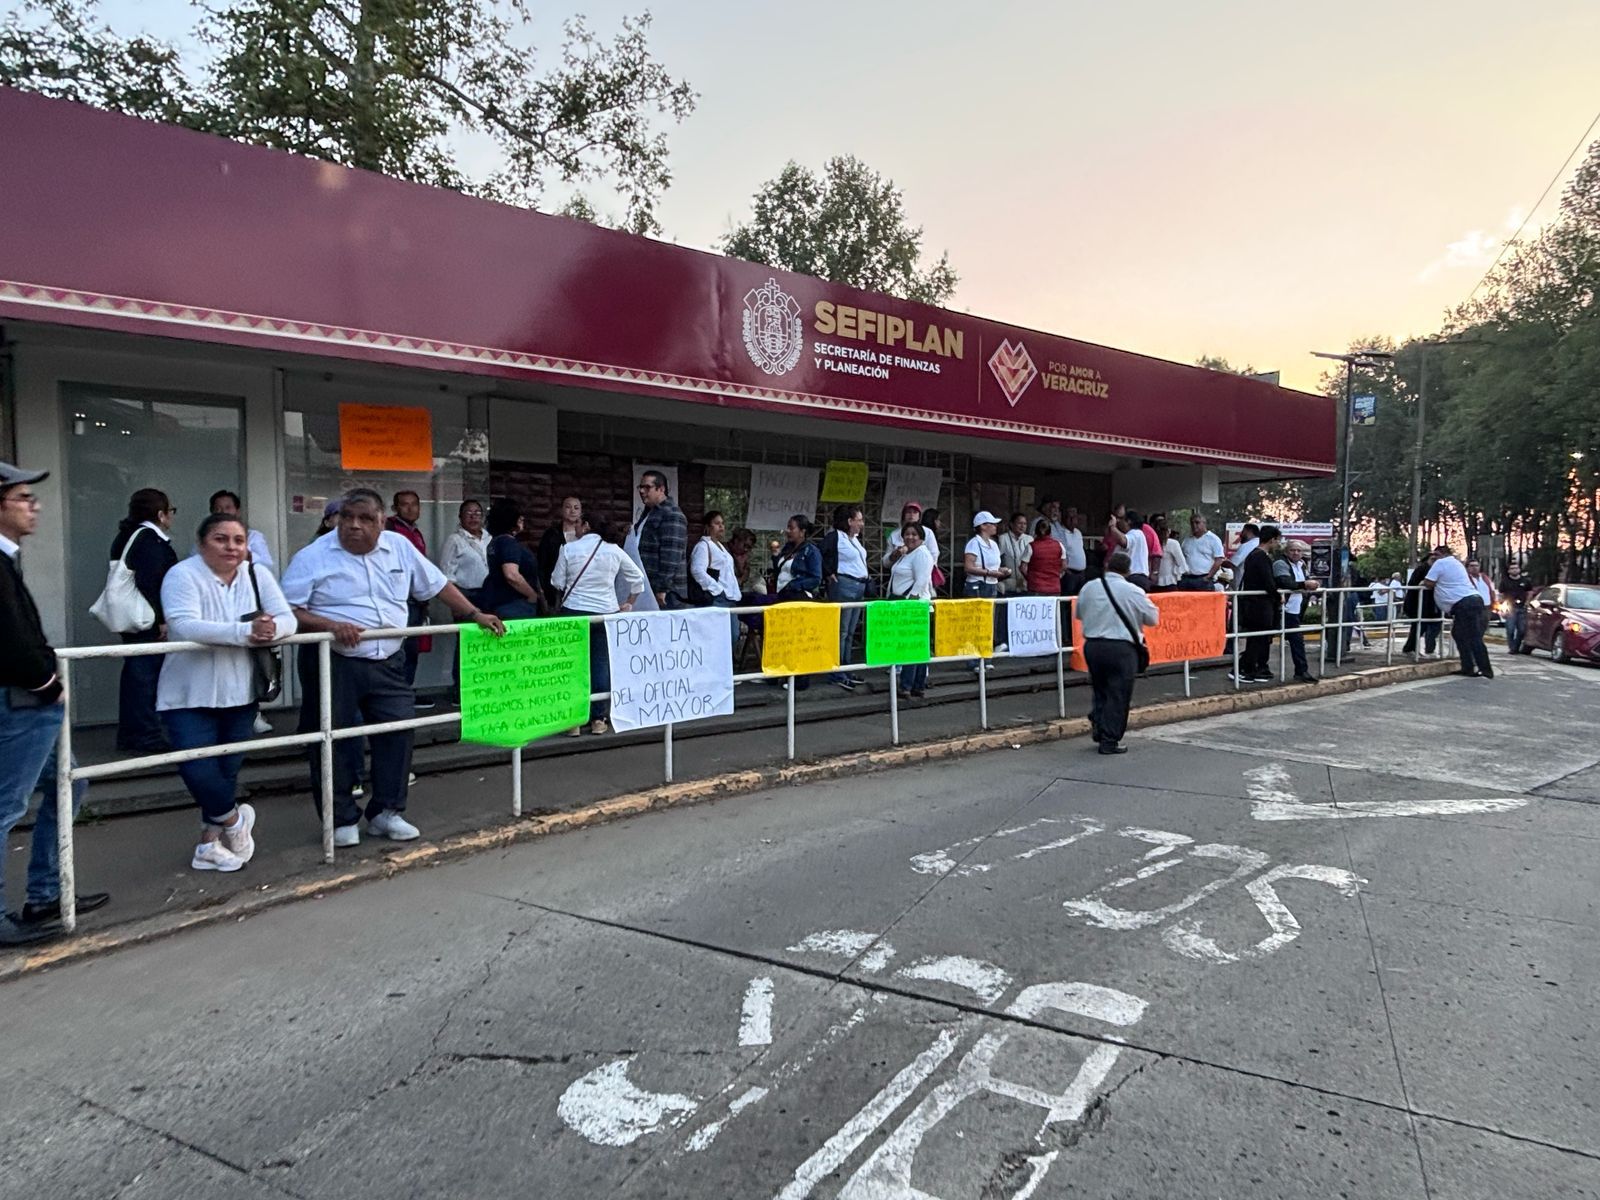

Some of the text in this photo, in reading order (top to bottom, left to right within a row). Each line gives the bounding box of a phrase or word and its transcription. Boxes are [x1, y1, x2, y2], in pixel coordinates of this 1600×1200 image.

[814, 300, 964, 360] SEFIPLAN
[814, 342, 941, 375] SECRETARÍA DE FINANZAS
[814, 358, 890, 380] Y PLANEACIÓN
[1048, 361, 1102, 381] POR AMOR A
[1041, 372, 1109, 398] VERACRUZ
[1015, 603, 1053, 621] PAGO DE
[616, 618, 690, 647] POR LA
[530, 647, 567, 661] XALAPA
[629, 646, 703, 675] OMISION
[1165, 640, 1212, 660] QUINCENA
[472, 669, 517, 684] ESTAMOS
[471, 687, 493, 700] POR
[527, 690, 572, 709] NUESTRO
[612, 677, 695, 709] DEL OFICIAL
[638, 693, 715, 726] MAYOR
